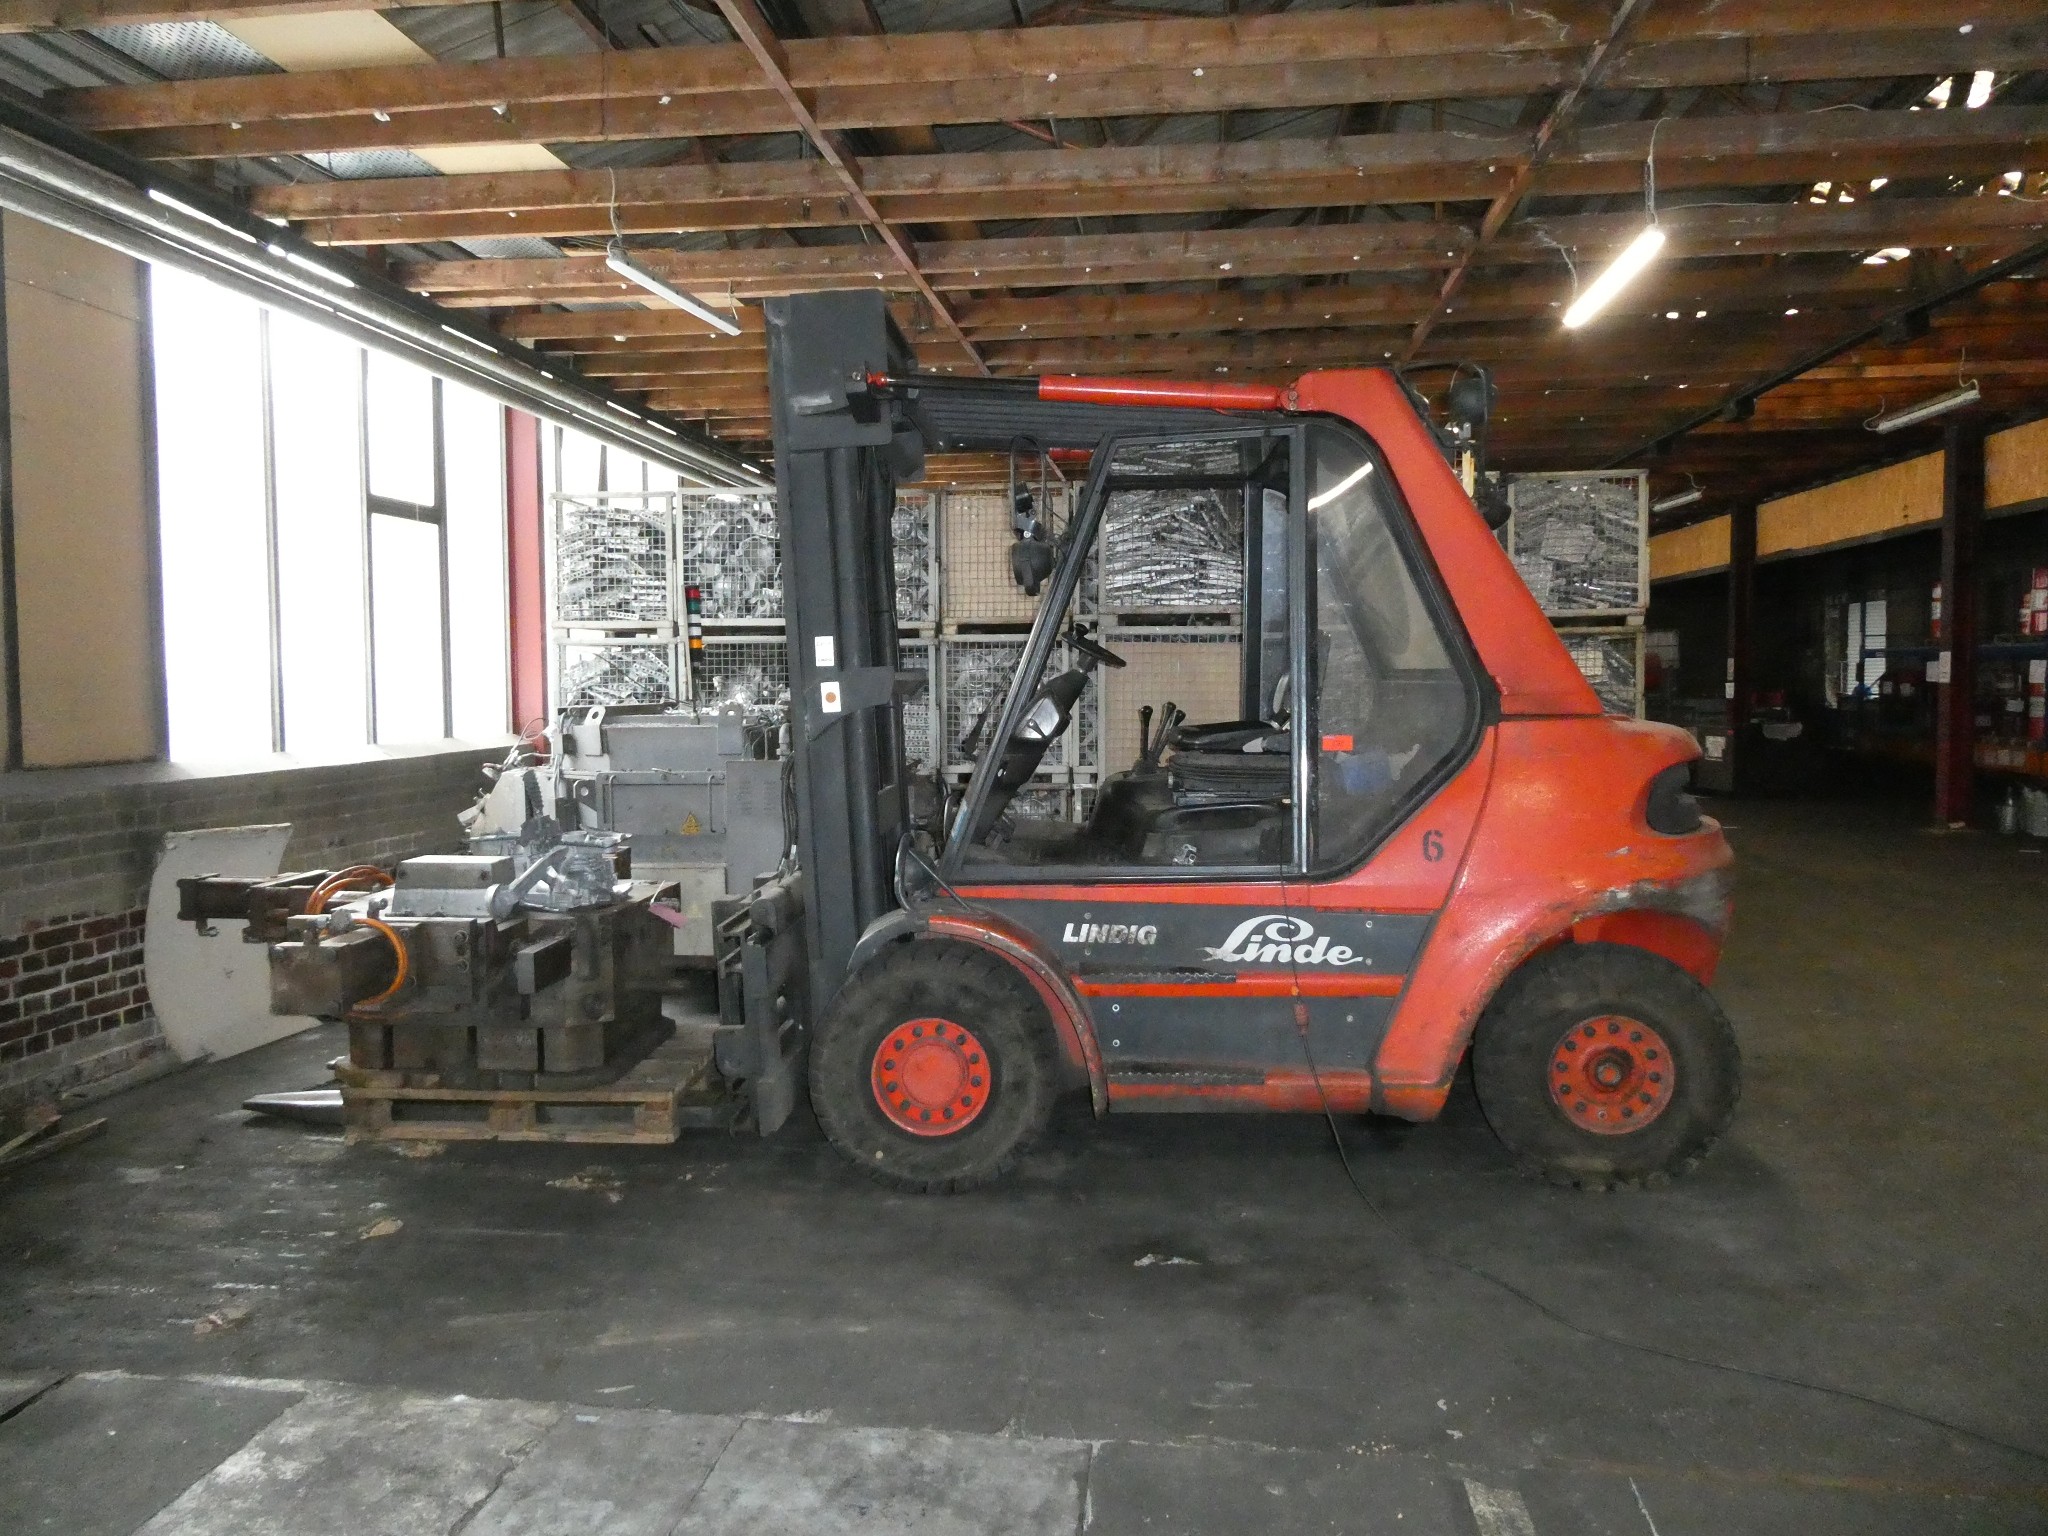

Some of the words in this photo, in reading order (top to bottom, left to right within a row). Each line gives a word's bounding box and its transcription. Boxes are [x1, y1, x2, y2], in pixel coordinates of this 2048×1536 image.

[1423, 829, 1444, 863] 6
[1062, 922, 1158, 946] LINDIG
[1203, 914, 1364, 966] Linde
